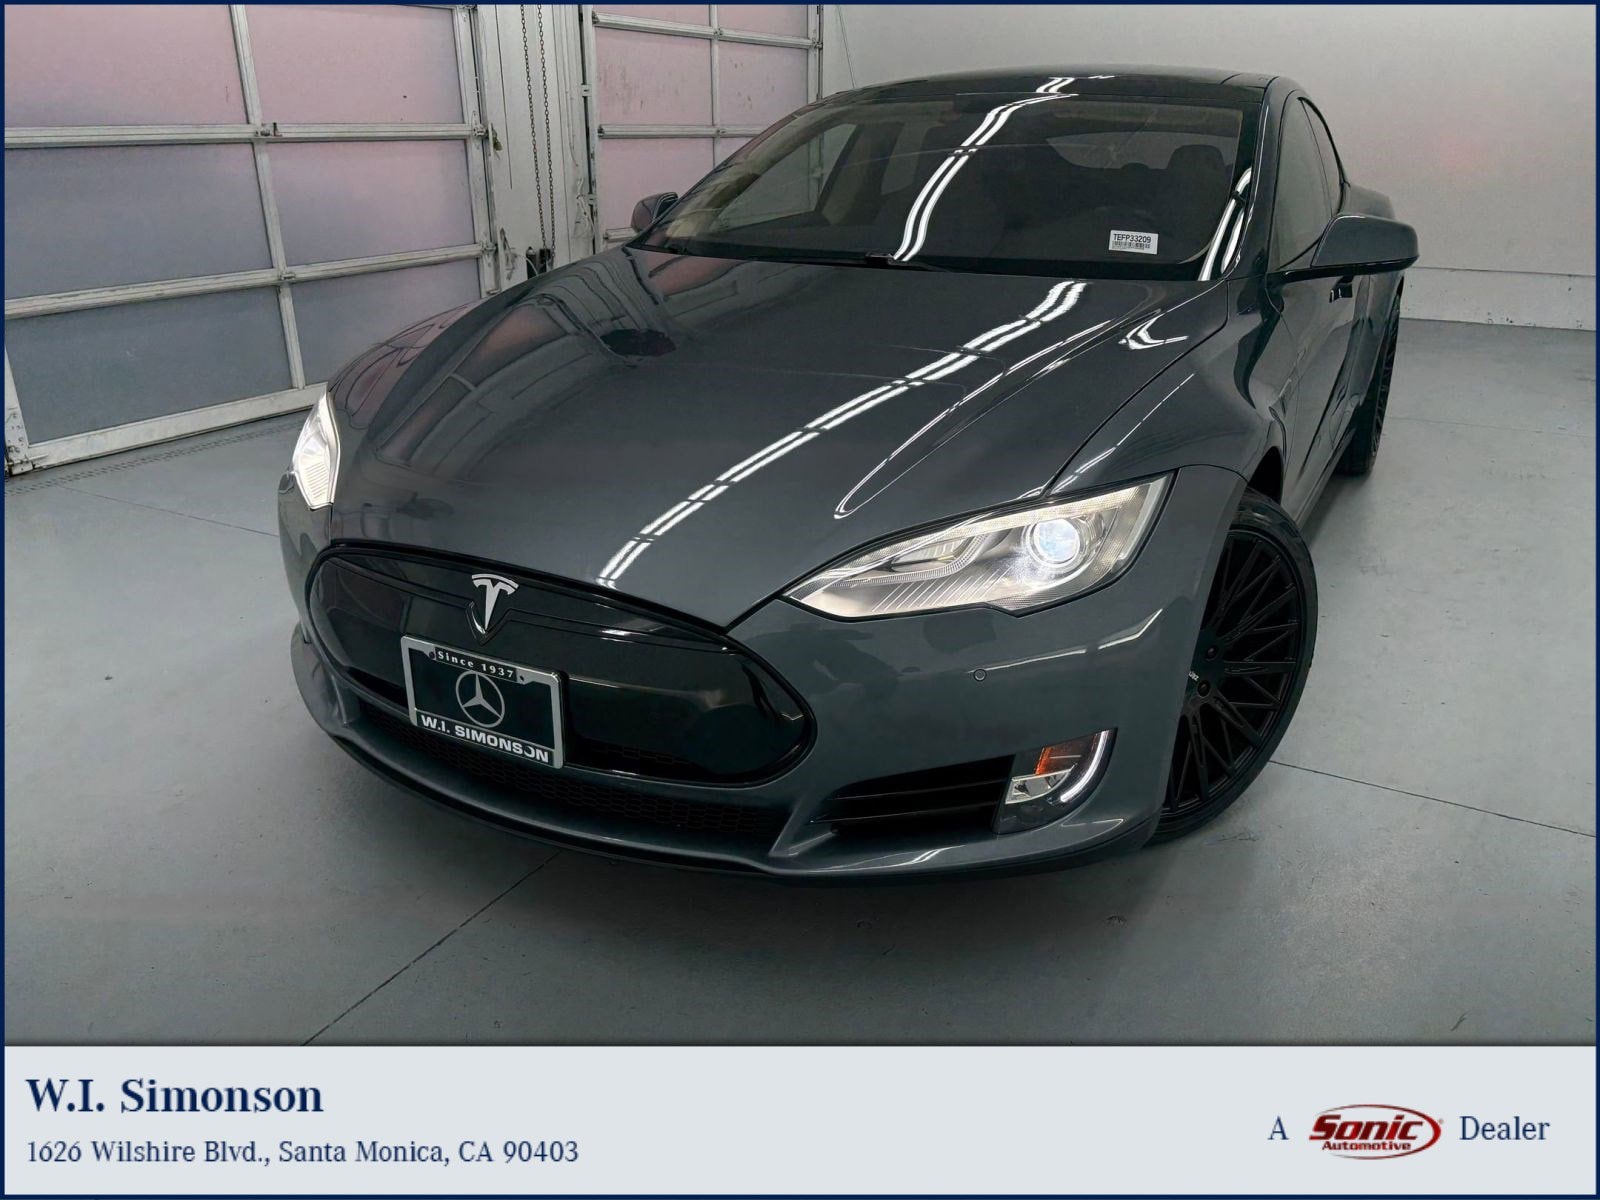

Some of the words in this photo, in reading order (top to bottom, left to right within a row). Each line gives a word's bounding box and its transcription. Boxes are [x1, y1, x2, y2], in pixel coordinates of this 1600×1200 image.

[1113, 233, 1152, 244] TEFP33209
[437, 650, 474, 668] Since
[481, 663, 514, 679] 1937
[421, 714, 450, 734] W.I.
